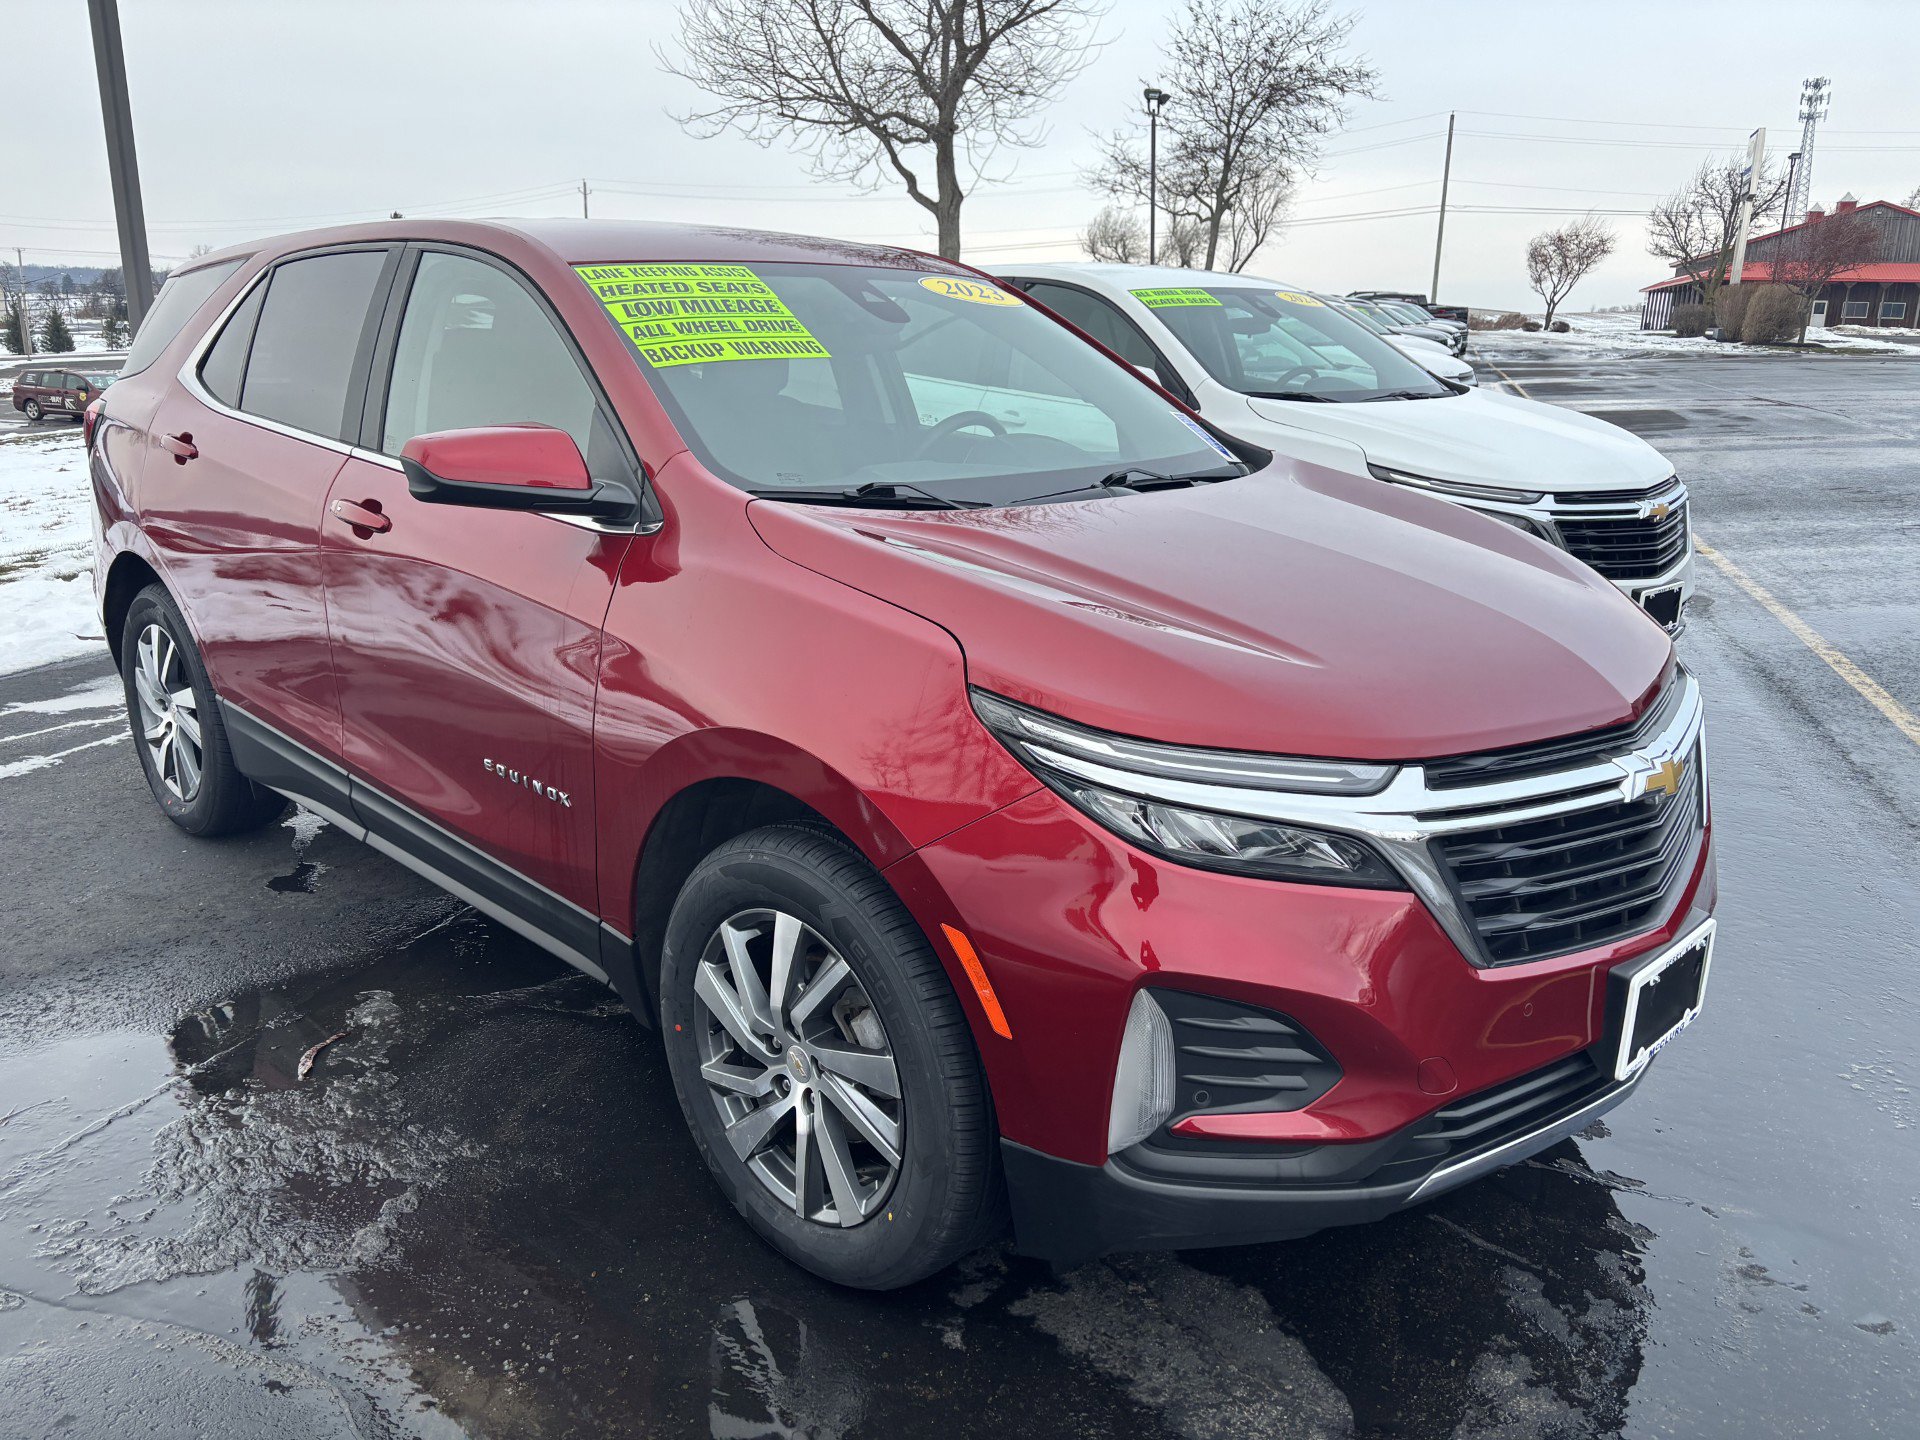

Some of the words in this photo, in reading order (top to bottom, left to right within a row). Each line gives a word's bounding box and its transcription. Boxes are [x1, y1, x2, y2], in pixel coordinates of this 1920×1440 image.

[581, 268, 629, 280] LANE
[627, 266, 699, 277] KEEPING
[700, 266, 753, 277] ASSIST
[598, 282, 691, 297] HEATED
[696, 281, 768, 294] SEATS
[937, 280, 1004, 301] 2023
[621, 300, 677, 318] LOW
[678, 299, 782, 315] MILEAGE
[1145, 298, 1185, 306] HEATED
[633, 323, 672, 340] ALL
[672, 320, 742, 335] WHEEL
[742, 319, 802, 333] DRIVE
[643, 341, 725, 364] BACKUP
[726, 340, 825, 356] WARNING
[483, 758, 572, 808] EQUINOX
[850, 938, 894, 1006] ECO
